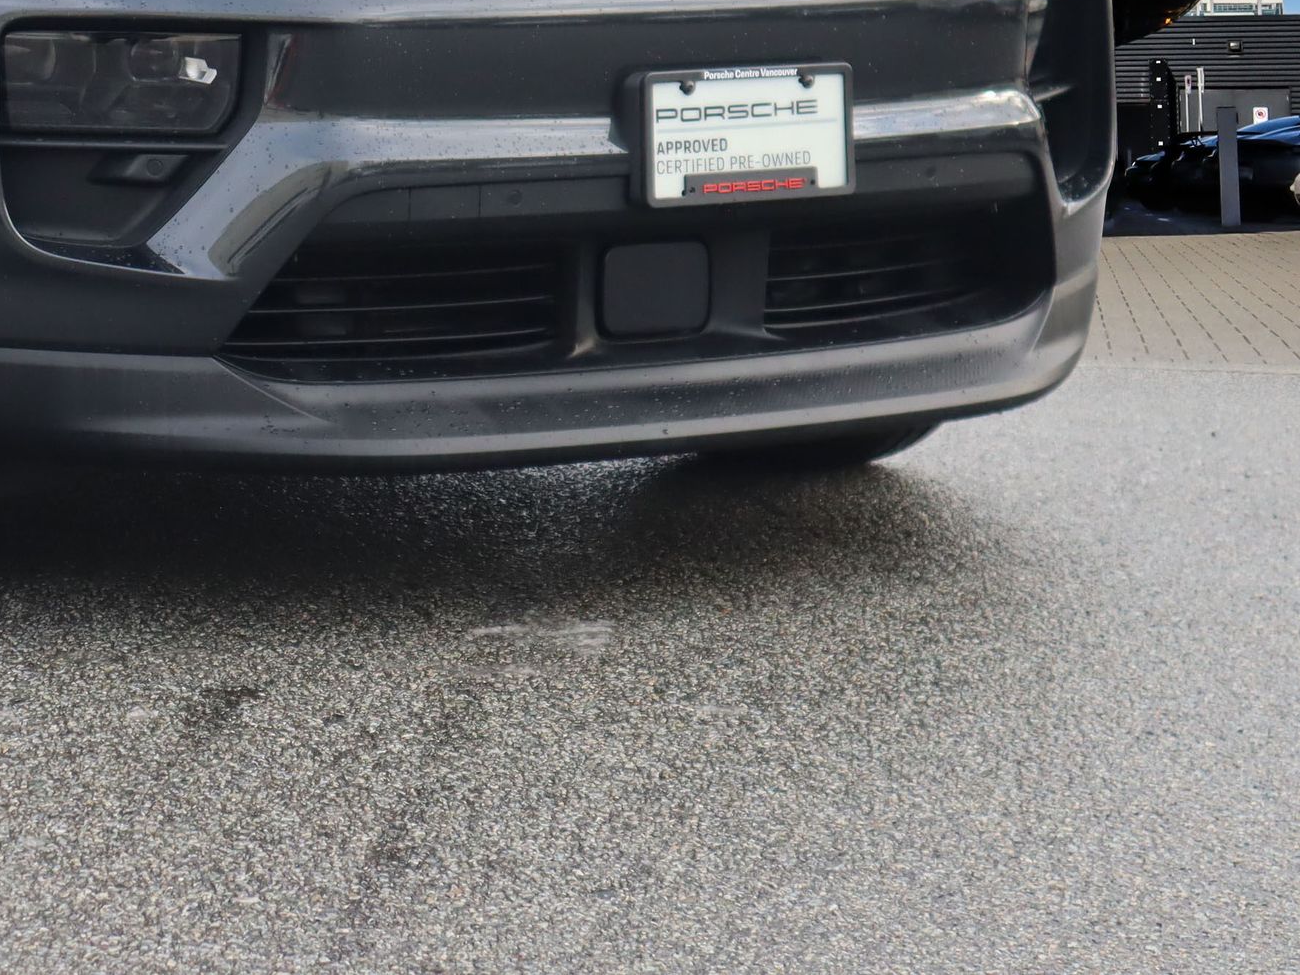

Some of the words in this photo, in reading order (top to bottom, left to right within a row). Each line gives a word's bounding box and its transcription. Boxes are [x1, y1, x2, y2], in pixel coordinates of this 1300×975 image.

[704, 70, 734, 80] Porsche
[735, 69, 760, 78] Centre
[761, 67, 798, 77] Vancouver
[656, 99, 818, 123] PORSCHE
[657, 138, 728, 155] APPROVED
[657, 157, 725, 174] CERTIFIED
[730, 150, 811, 170] PRE-OWNED
[703, 178, 806, 194] PORSCHE
